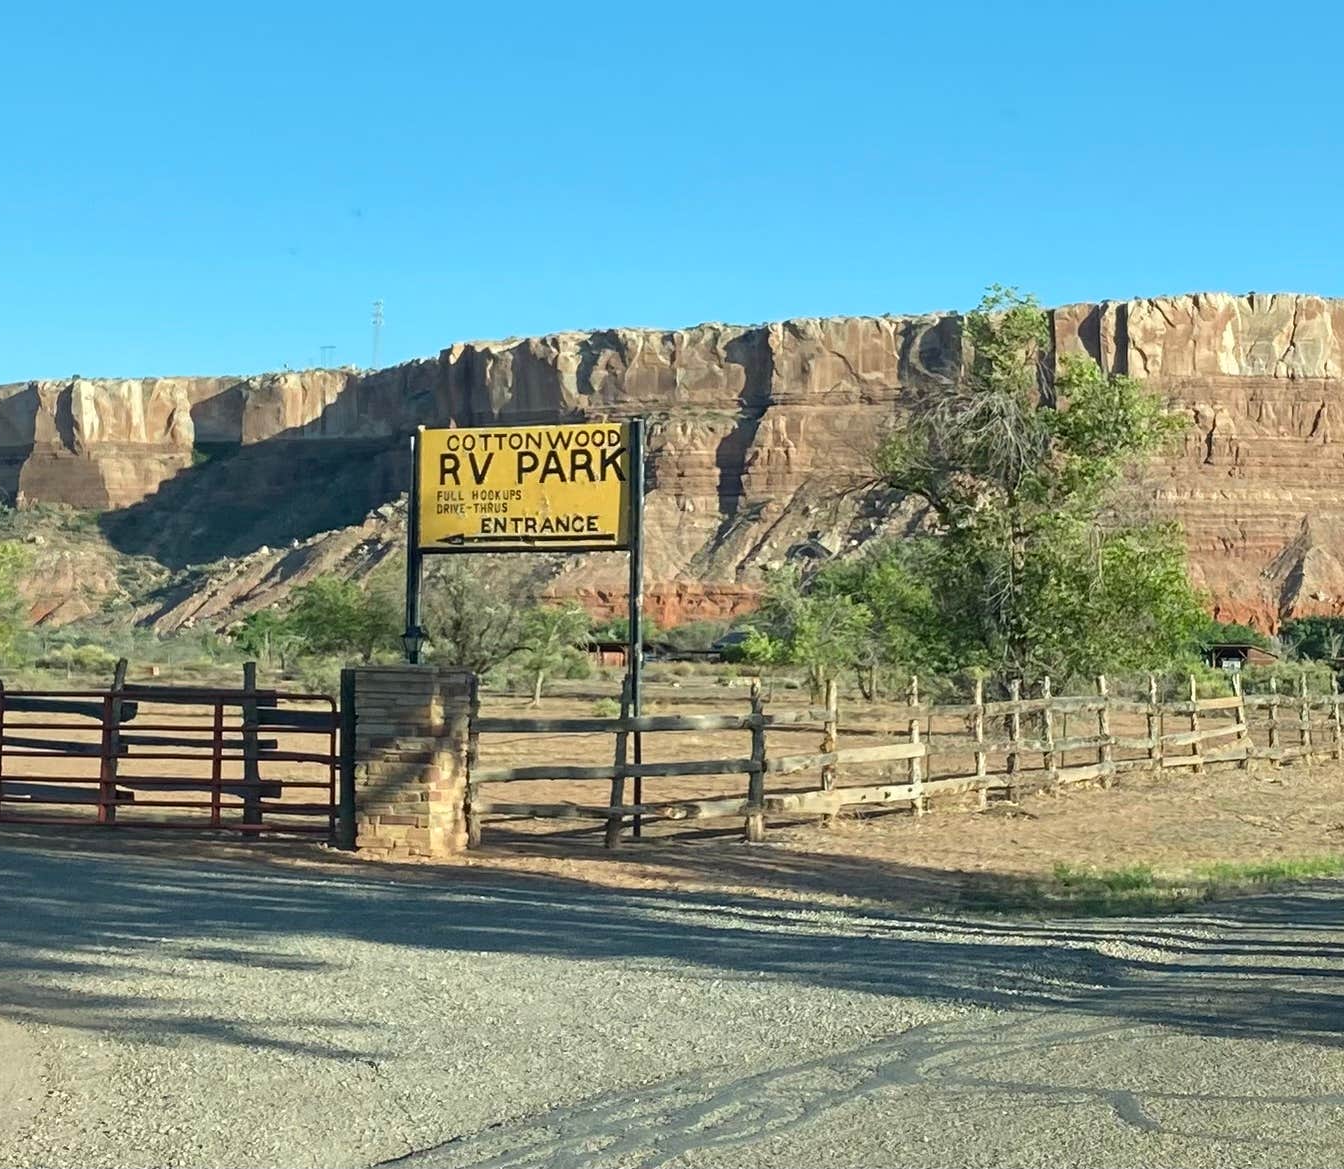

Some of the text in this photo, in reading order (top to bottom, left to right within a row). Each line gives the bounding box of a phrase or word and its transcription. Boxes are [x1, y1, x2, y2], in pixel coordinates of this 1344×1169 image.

[446, 429, 621, 452] COTTONWOOD
[439, 447, 627, 486] RV PARK
[436, 490, 464, 502] FULL
[436, 502, 508, 514] DRIVE-THRUS
[480, 515, 599, 534] ENTRANCE
